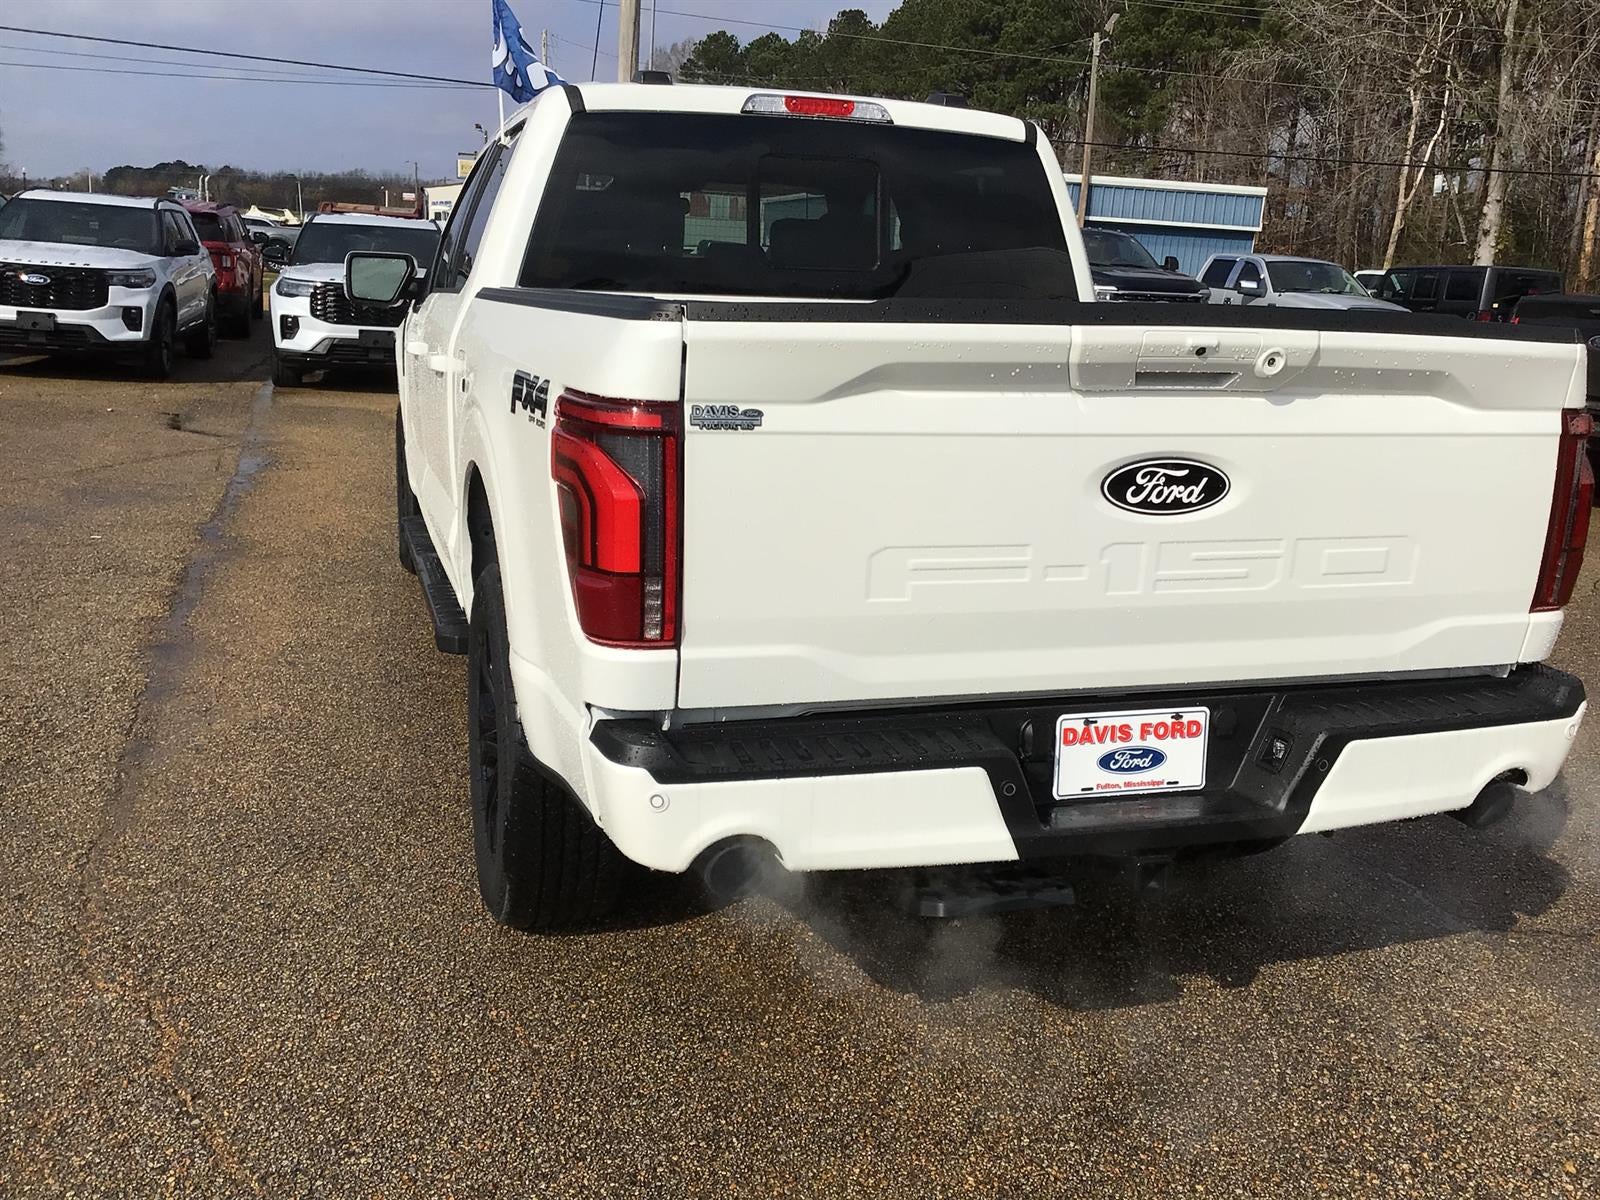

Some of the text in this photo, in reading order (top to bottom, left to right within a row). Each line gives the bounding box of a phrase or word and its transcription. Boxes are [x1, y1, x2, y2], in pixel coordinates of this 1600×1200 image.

[510, 369, 550, 420] FX4
[692, 405, 739, 418] DAVIS
[1126, 468, 1206, 505] Ford
[866, 534, 1417, 602] F-150
[1063, 720, 1202, 746] DAVIS FORD
[1109, 750, 1153, 769] Ford
[1096, 779, 1165, 790] Fulton, Mississippi
